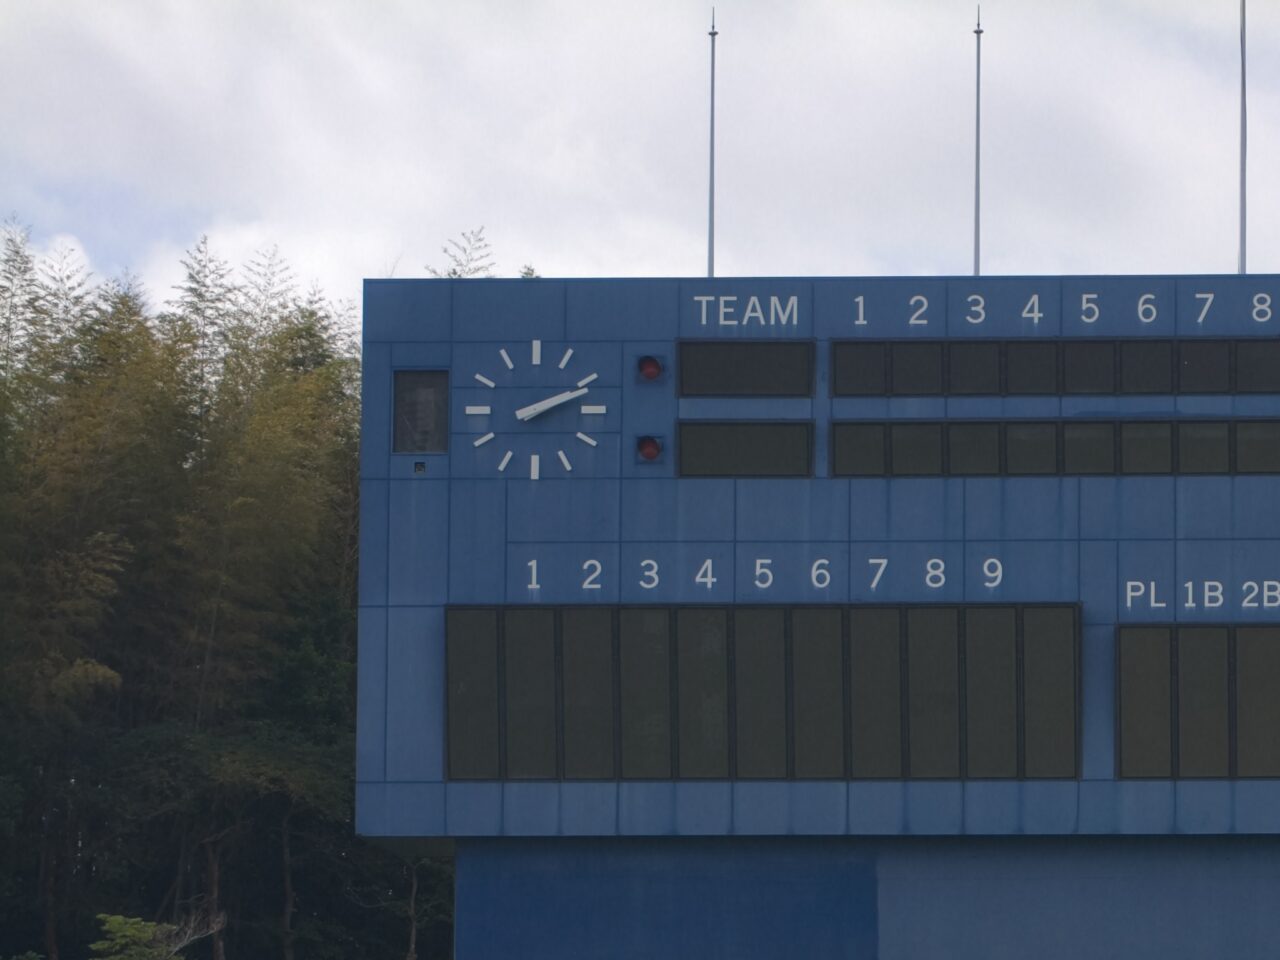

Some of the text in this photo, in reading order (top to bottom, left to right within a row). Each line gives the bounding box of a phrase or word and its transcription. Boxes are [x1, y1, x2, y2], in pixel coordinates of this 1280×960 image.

[693, 295, 798, 325] TEAM
[855, 295, 867, 325] 1
[909, 295, 928, 325] 2
[966, 294, 986, 324] 3
[1022, 294, 1043, 324] 4
[1081, 294, 1099, 323] 5
[1137, 294, 1157, 323] 6
[1195, 293, 1214, 323] 7
[1252, 293, 1272, 322] 8
[527, 558, 1003, 589] 1 2 3 4 5 6 7 8 9
[1126, 581, 1166, 607] PL
[1184, 581, 1224, 607] 1B
